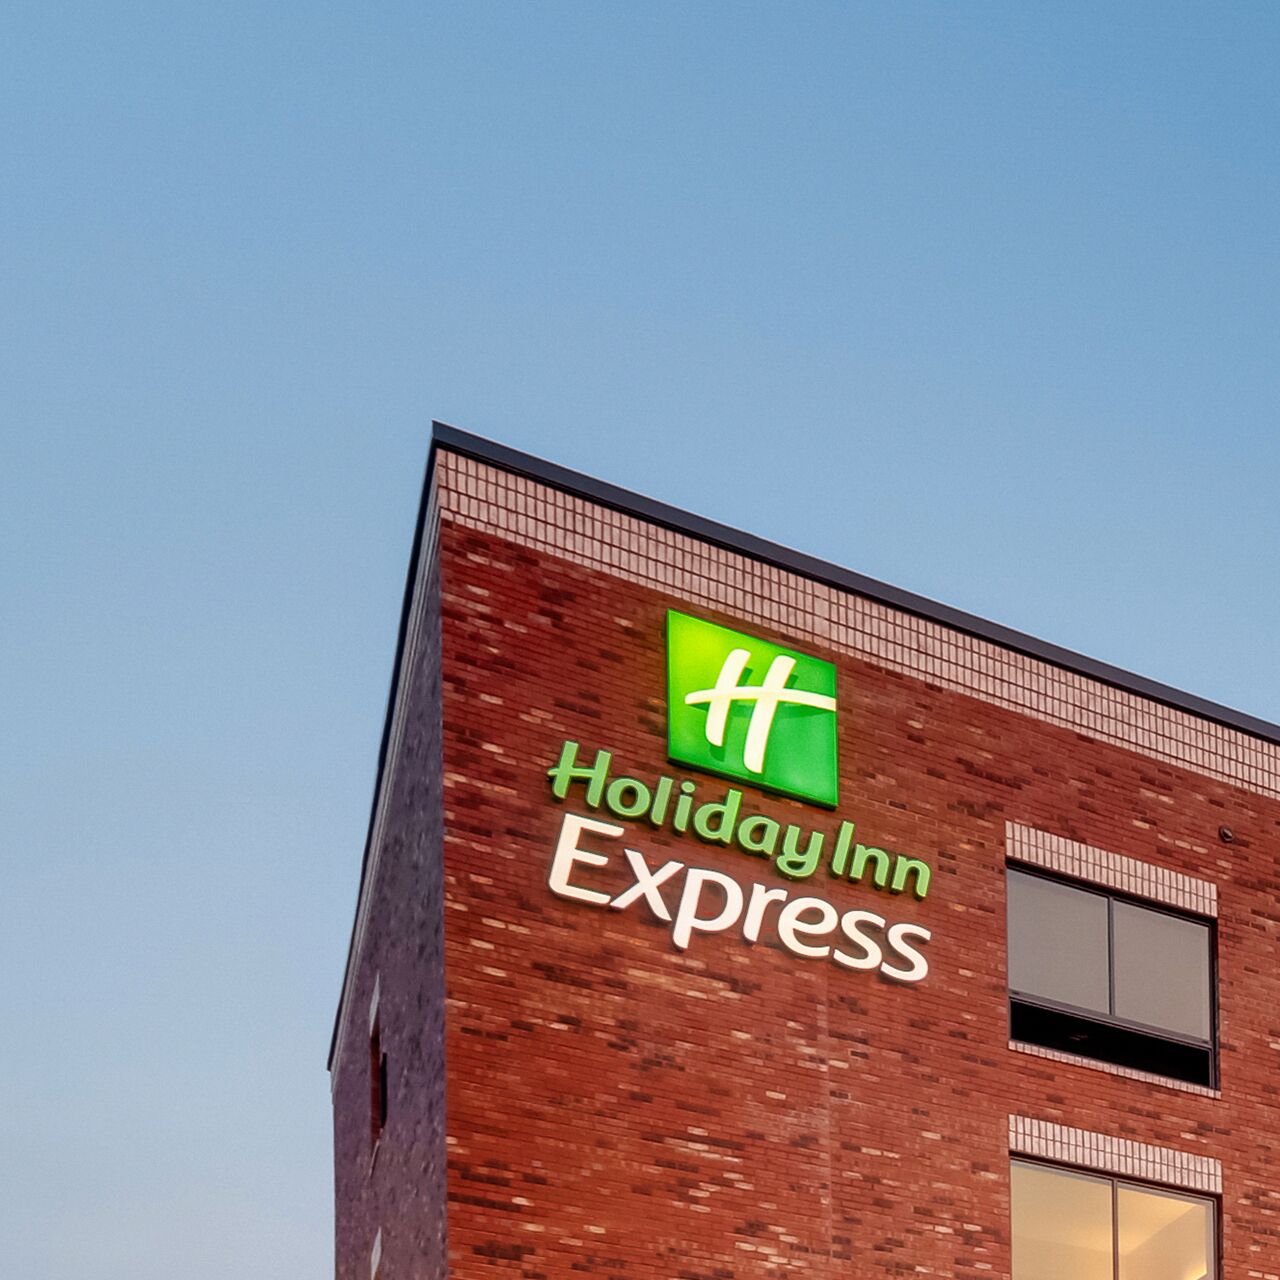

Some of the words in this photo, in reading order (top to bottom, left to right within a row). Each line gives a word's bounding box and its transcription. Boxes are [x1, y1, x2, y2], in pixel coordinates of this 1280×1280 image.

[547, 741, 825, 879] Holiday
[830, 821, 932, 899] Inn
[548, 813, 932, 981] Express
